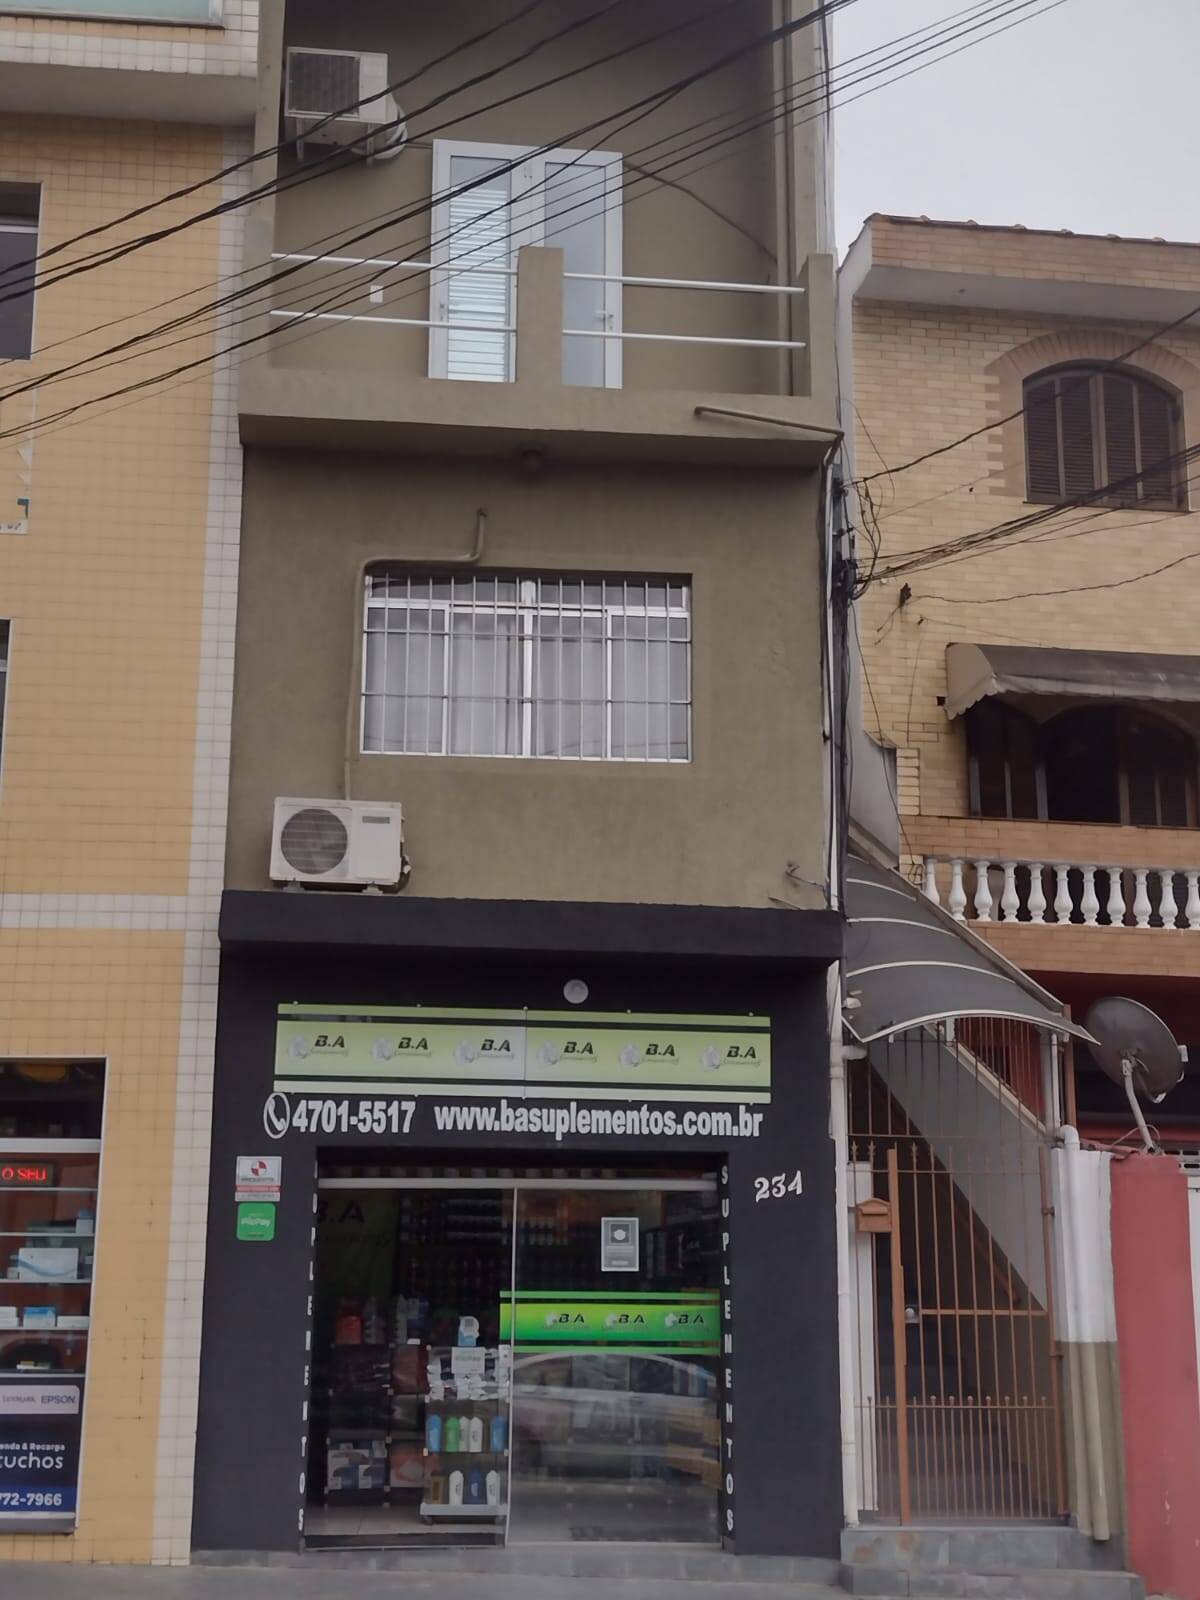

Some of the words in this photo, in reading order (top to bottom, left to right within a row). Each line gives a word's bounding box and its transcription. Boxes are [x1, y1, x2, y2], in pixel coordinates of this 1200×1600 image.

[314, 1035, 345, 1048] B.A
[398, 1037, 429, 1050] B.A
[480, 1039, 511, 1052] B.A
[563, 1041, 594, 1055] B.A
[645, 1043, 676, 1057] B.A
[726, 1046, 757, 1059] B.A
[292, 1100, 416, 1133] 4701-5517
[434, 1099, 763, 1141] www.basuplementos.com.br
[754, 1170, 802, 1203] 234
[41, 1395, 76, 1404] EPSON
